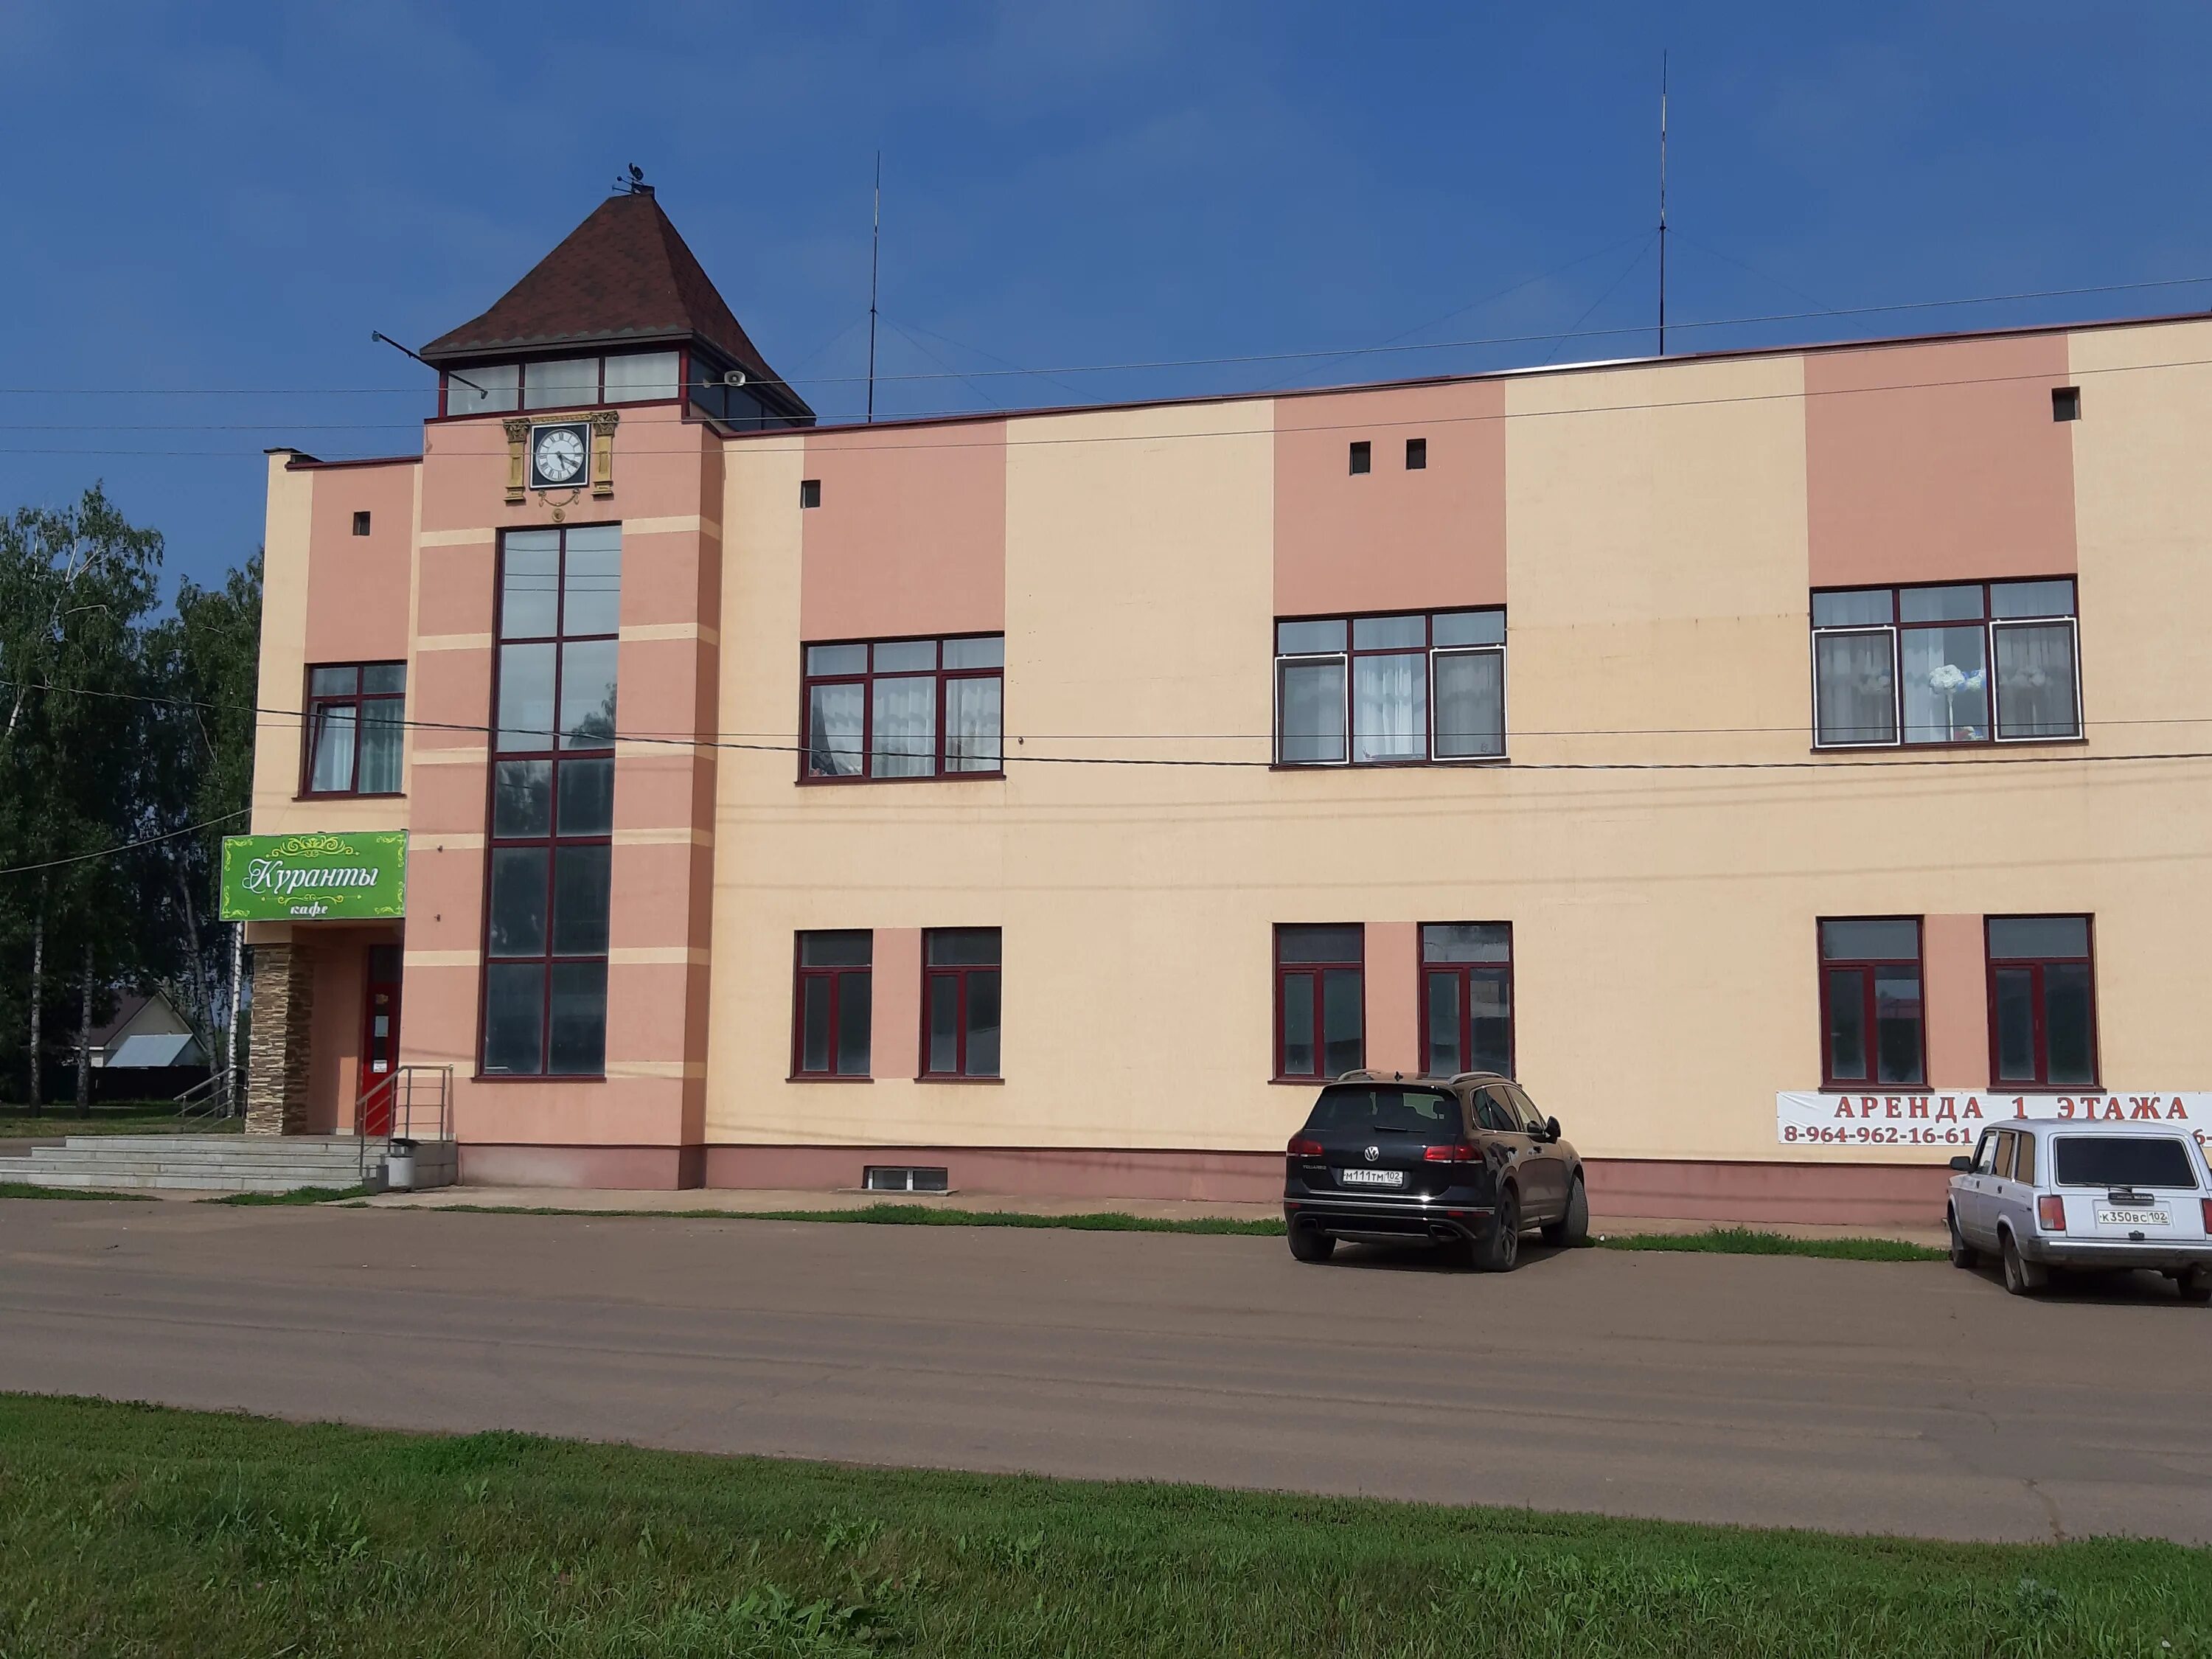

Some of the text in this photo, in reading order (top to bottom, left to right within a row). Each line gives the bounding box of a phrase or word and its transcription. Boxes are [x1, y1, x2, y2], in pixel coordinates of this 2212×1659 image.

[242, 858, 379, 894] Куранты
[291, 901, 328, 917] кафе
[1834, 1096, 2188, 1124] АРЕНДА 1 ЭТАЖА
[1784, 1125, 1973, 1144] 8-964-962-16-61
